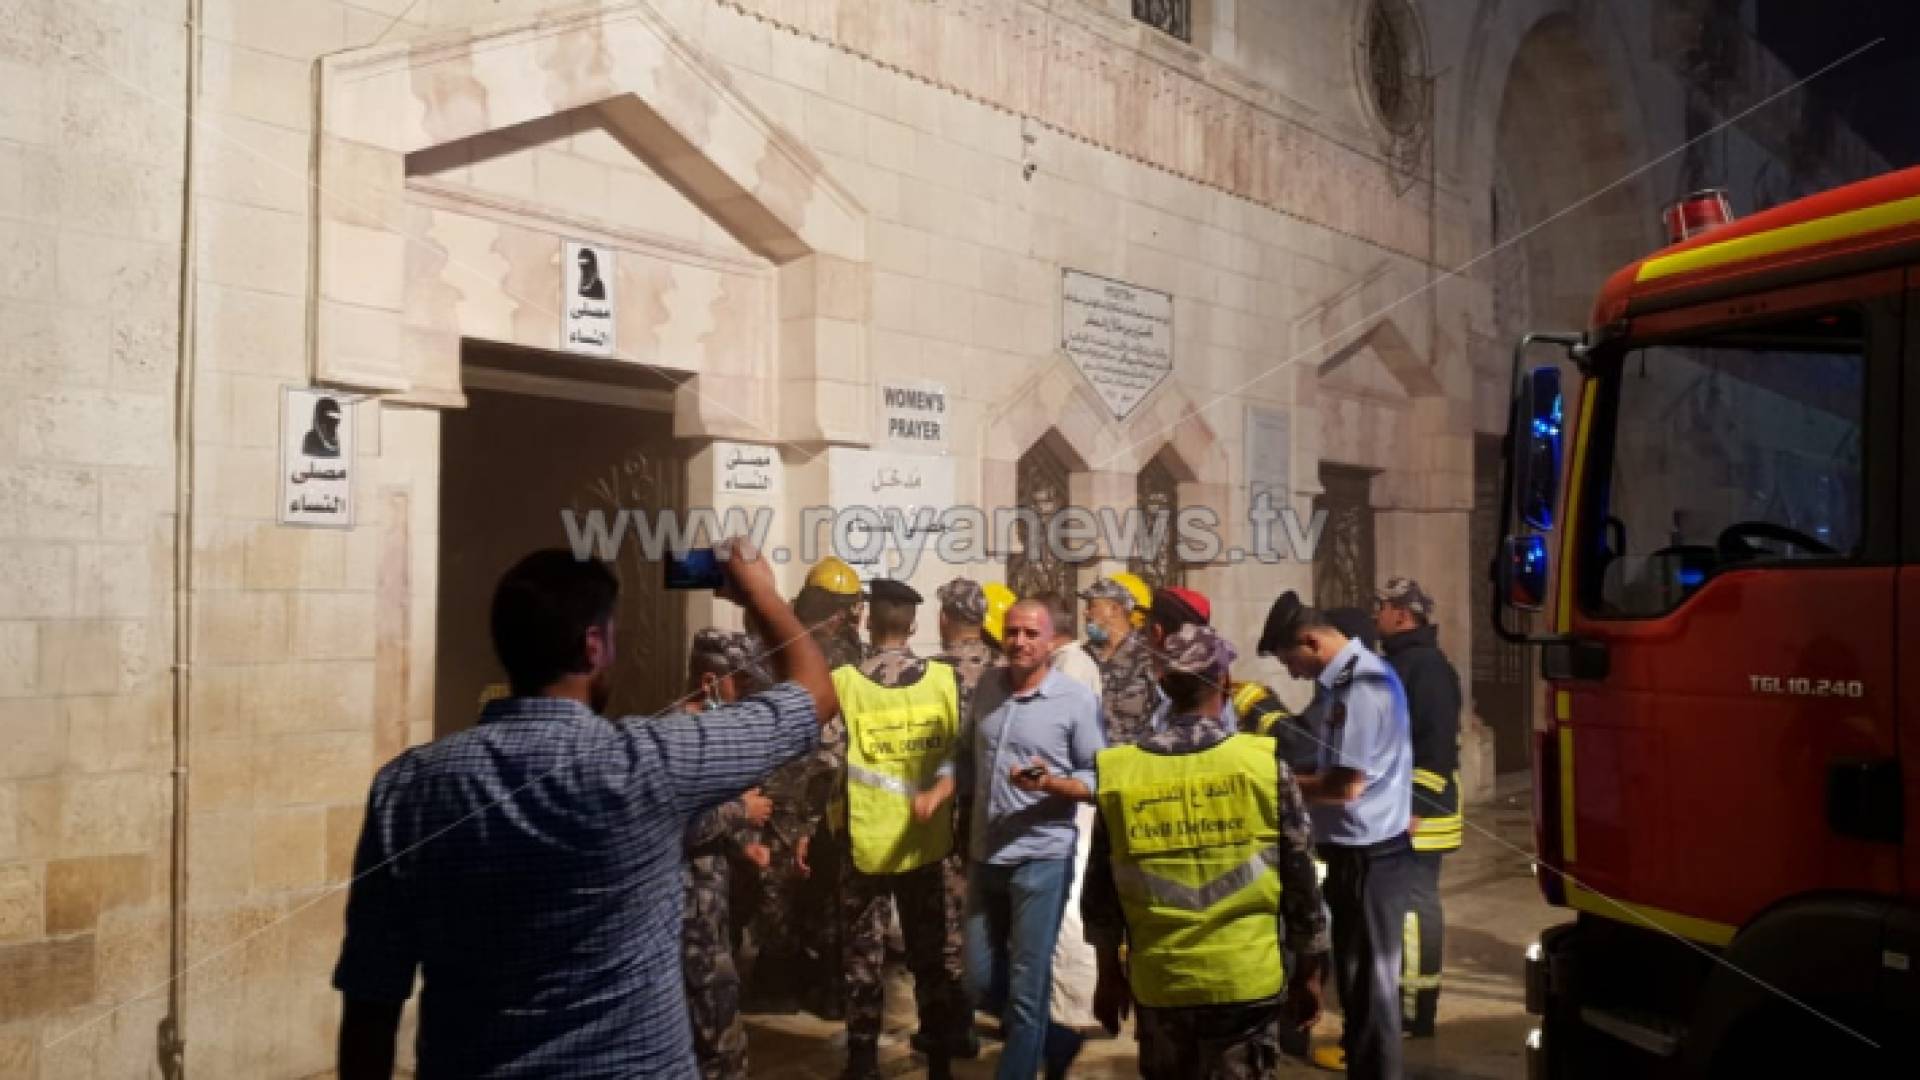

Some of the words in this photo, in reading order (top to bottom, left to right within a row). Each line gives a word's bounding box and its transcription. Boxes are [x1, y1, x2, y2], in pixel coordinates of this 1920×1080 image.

[882, 386, 945, 413] WOMEN'S
[888, 418, 941, 441] PRAYER
[291, 461, 346, 484] مصلى
[1749, 674, 1785, 694] TGL
[1787, 677, 1864, 698] 10.240
[1127, 821, 1172, 839] Civil
[1175, 816, 1245, 836] Defence
